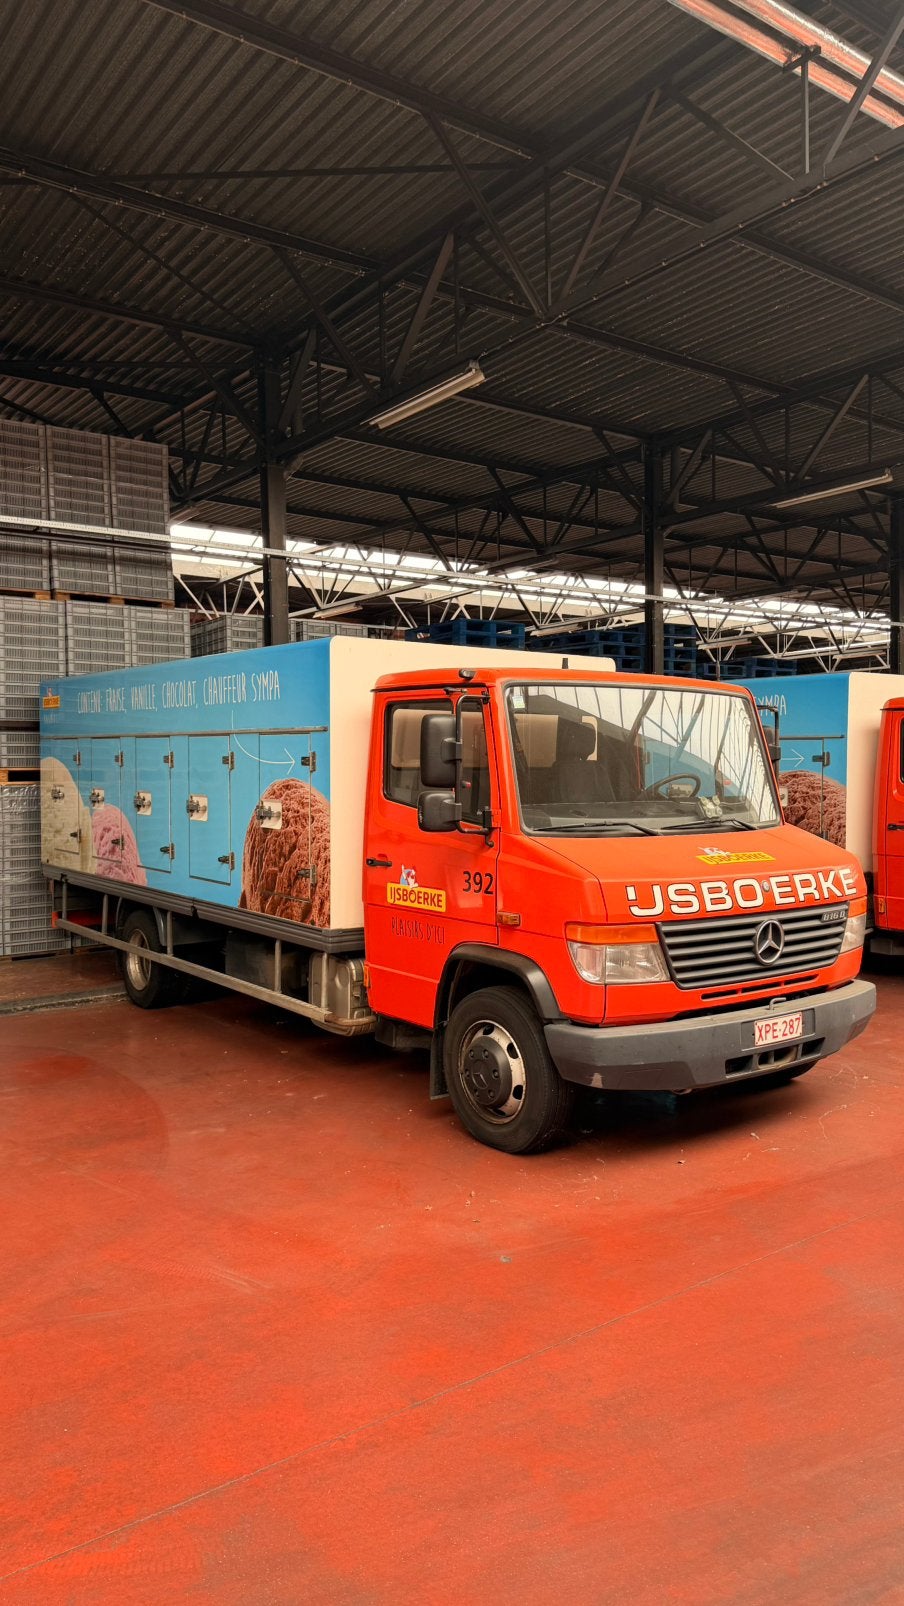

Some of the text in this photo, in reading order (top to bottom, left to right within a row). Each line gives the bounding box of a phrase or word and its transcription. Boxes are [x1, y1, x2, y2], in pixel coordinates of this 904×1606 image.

[131, 684, 158, 712] VANILLE,
[162, 680, 198, 709] CHOCOLAT,
[203, 672, 247, 705] CHAUFFEUR
[251, 670, 280, 702] SYMPA
[754, 694, 787, 716] YMPA
[462, 871, 494, 895] 392
[390, 886, 443, 909] IJSBOERKE
[391, 916, 445, 945] PLAISIRS D'ICI
